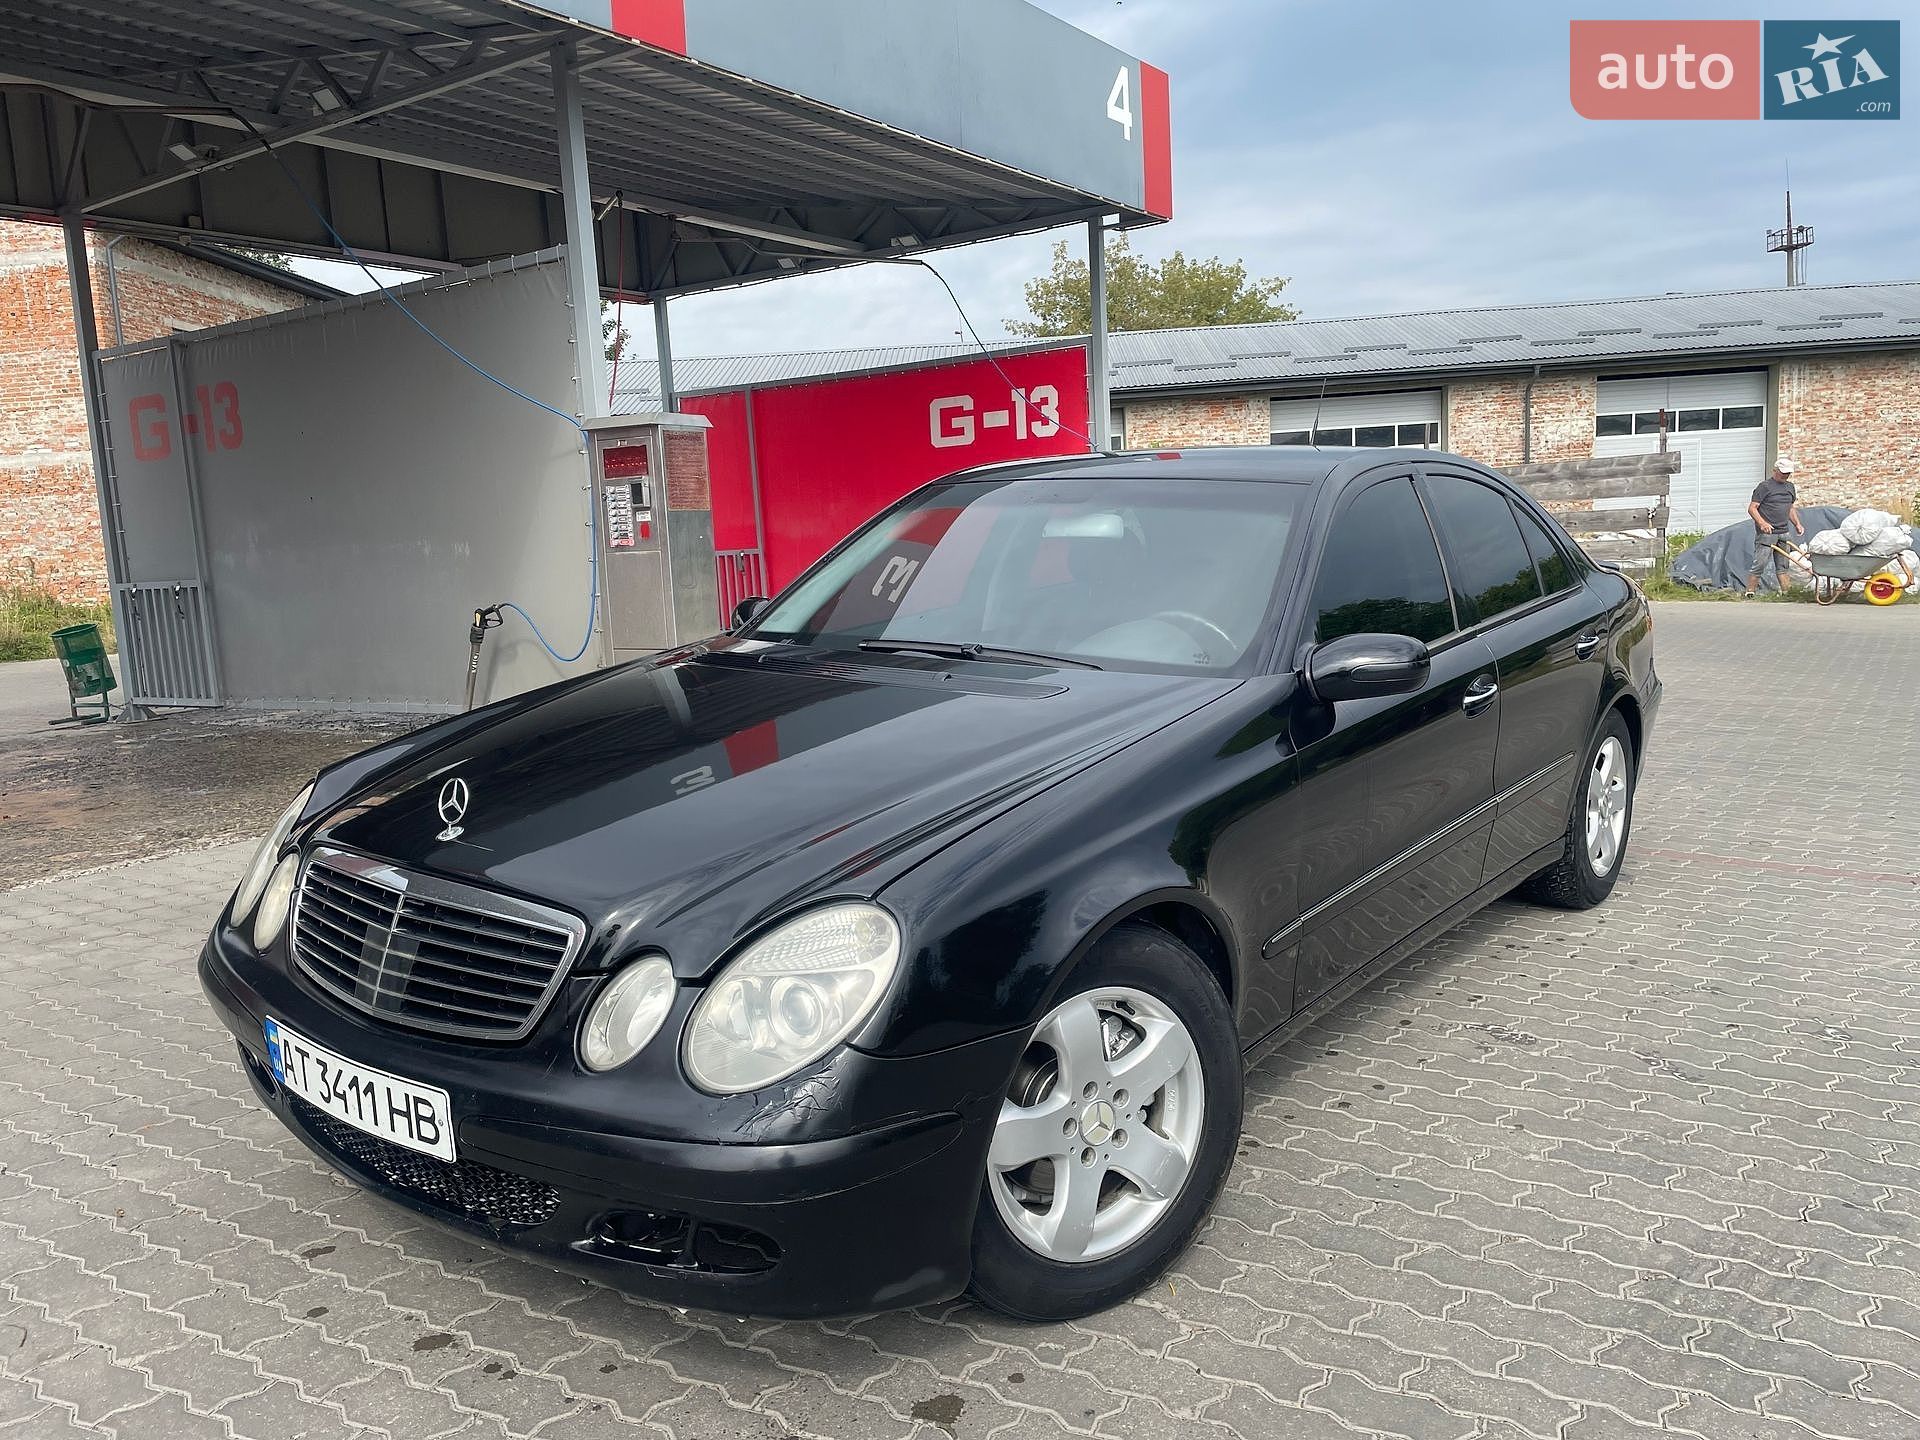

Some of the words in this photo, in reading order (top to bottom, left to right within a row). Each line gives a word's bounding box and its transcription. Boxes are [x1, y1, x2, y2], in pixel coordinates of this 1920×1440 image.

[1106, 65, 1133, 142] 4
[129, 381, 244, 462] G-13
[929, 384, 1060, 448] G-13
[273, 1056, 284, 1073] UA
[283, 1038, 310, 1092] AT
[315, 1058, 379, 1127] 3411
[386, 1086, 440, 1146] HB
